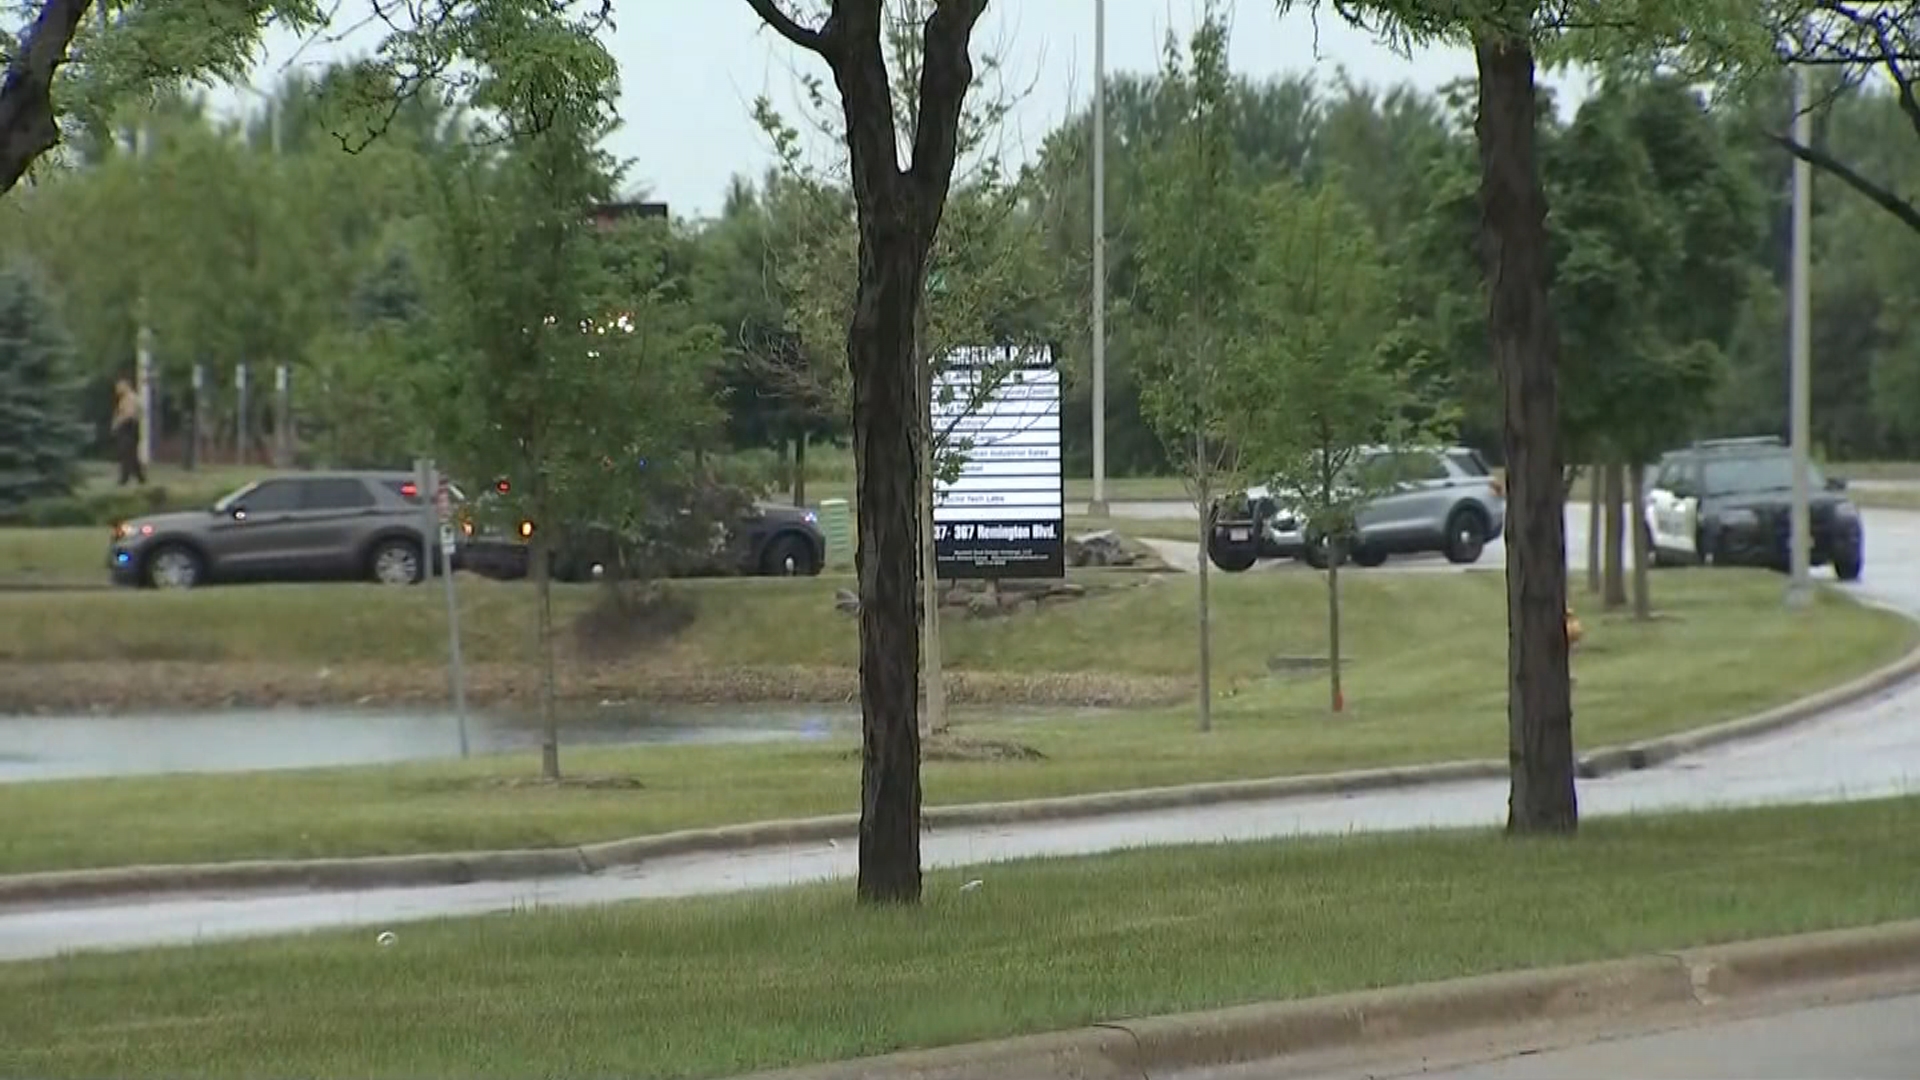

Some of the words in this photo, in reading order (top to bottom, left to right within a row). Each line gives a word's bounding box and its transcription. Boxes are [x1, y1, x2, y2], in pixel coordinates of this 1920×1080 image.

[1009, 344, 1052, 363] PAZA
[977, 523, 1031, 541] Remington
[1032, 523, 1058, 540] Blvd.
